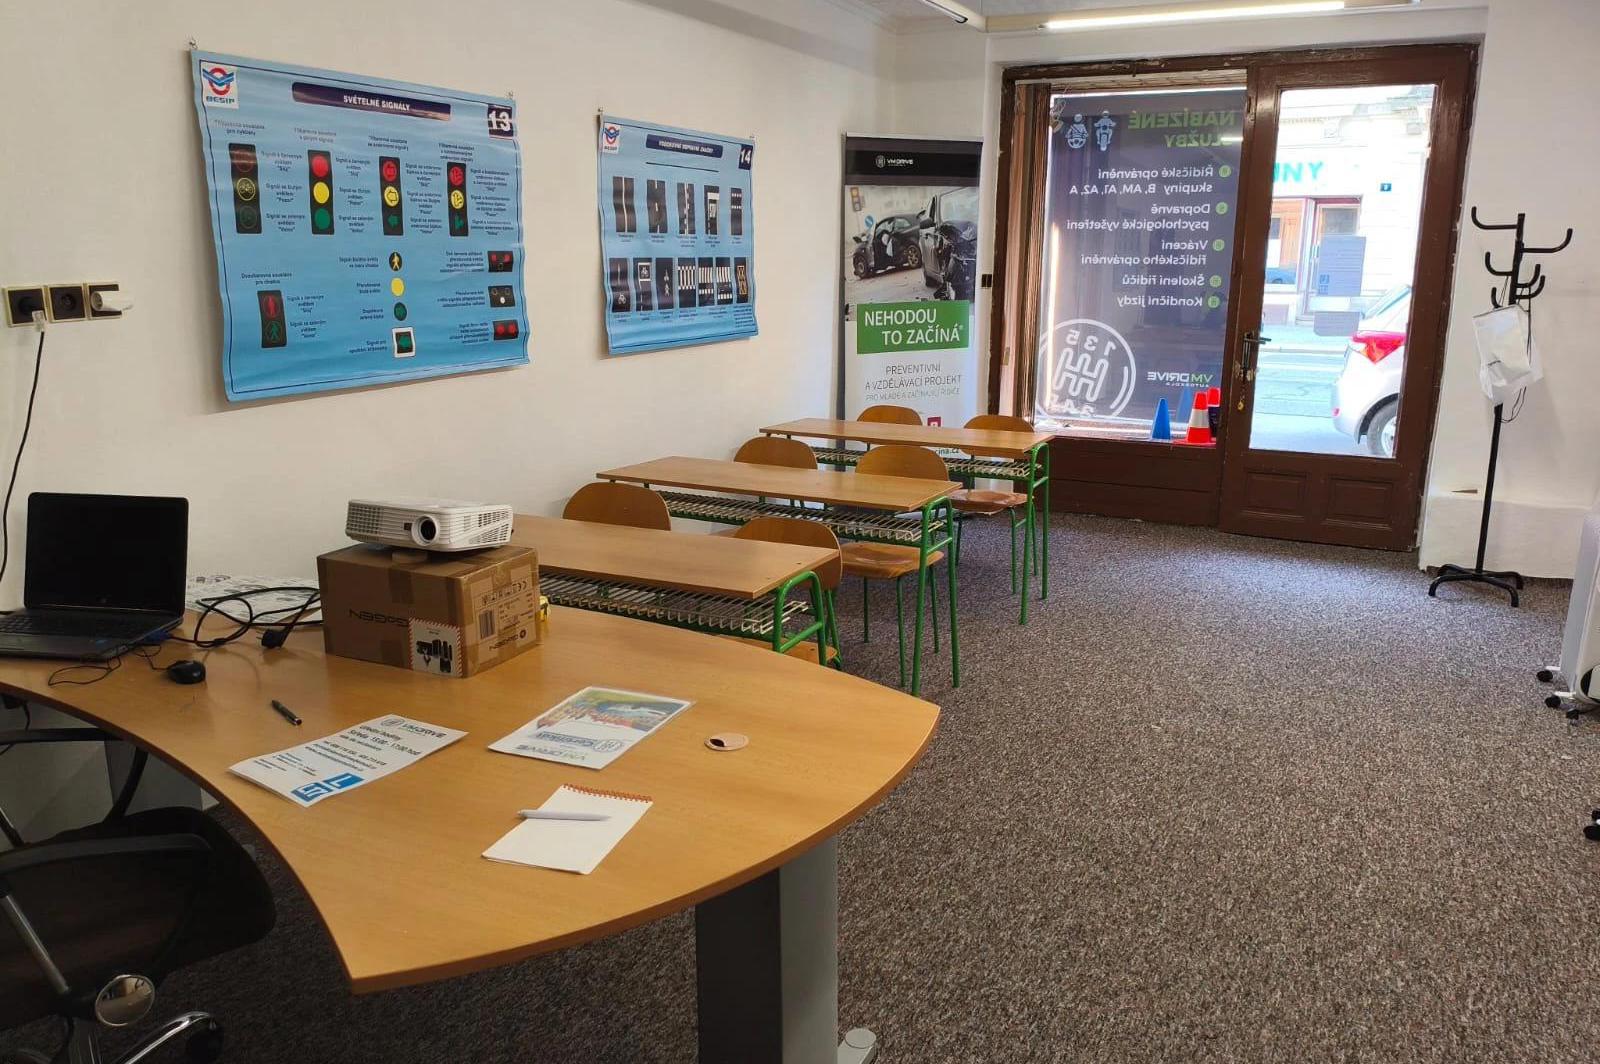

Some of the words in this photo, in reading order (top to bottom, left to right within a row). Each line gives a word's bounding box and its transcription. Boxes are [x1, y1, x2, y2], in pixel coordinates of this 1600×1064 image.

[488, 110, 511, 132] 13
[740, 148, 751, 164] 14
[864, 308, 937, 327] NEHODOU
[882, 330, 902, 345] TO
[906, 323, 960, 344] ZAČÍNÁ
[885, 363, 941, 375] PREVENTIVNÍ
[865, 381, 871, 390] A
[873, 376, 922, 390] VZDĚLÁVACÍ
[924, 374, 962, 386] PROJEKT
